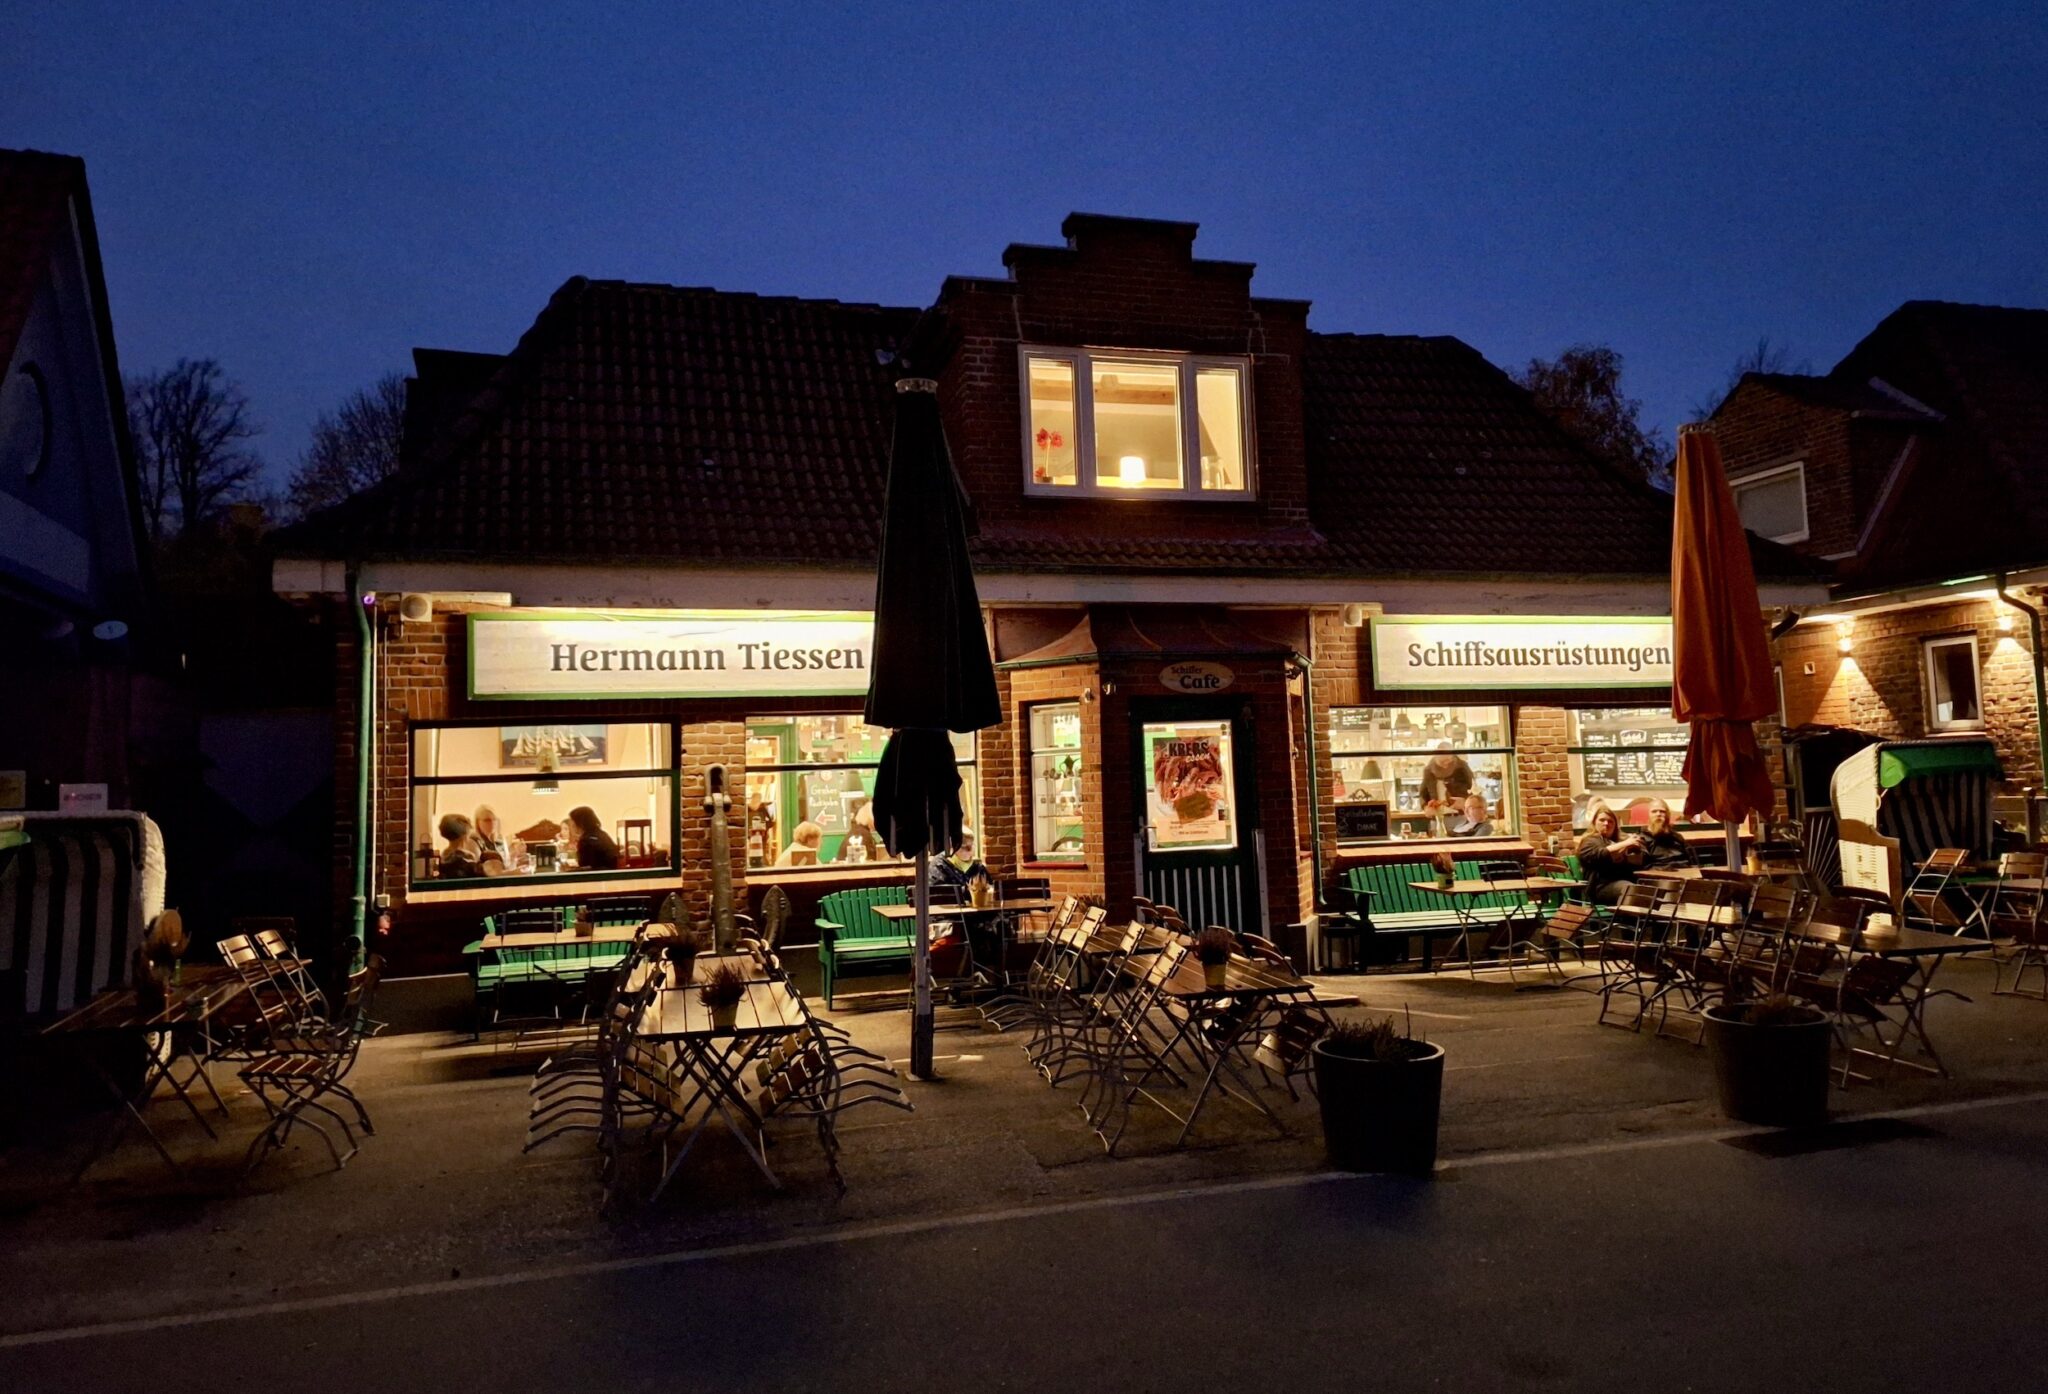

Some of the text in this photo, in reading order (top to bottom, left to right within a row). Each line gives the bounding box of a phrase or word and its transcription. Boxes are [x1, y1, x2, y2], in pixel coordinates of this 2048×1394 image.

[550, 641, 866, 672] Hermann Tiessen
[1407, 640, 1672, 672] Schiffsausrüstungen
[1169, 741, 1210, 757] KREBS
